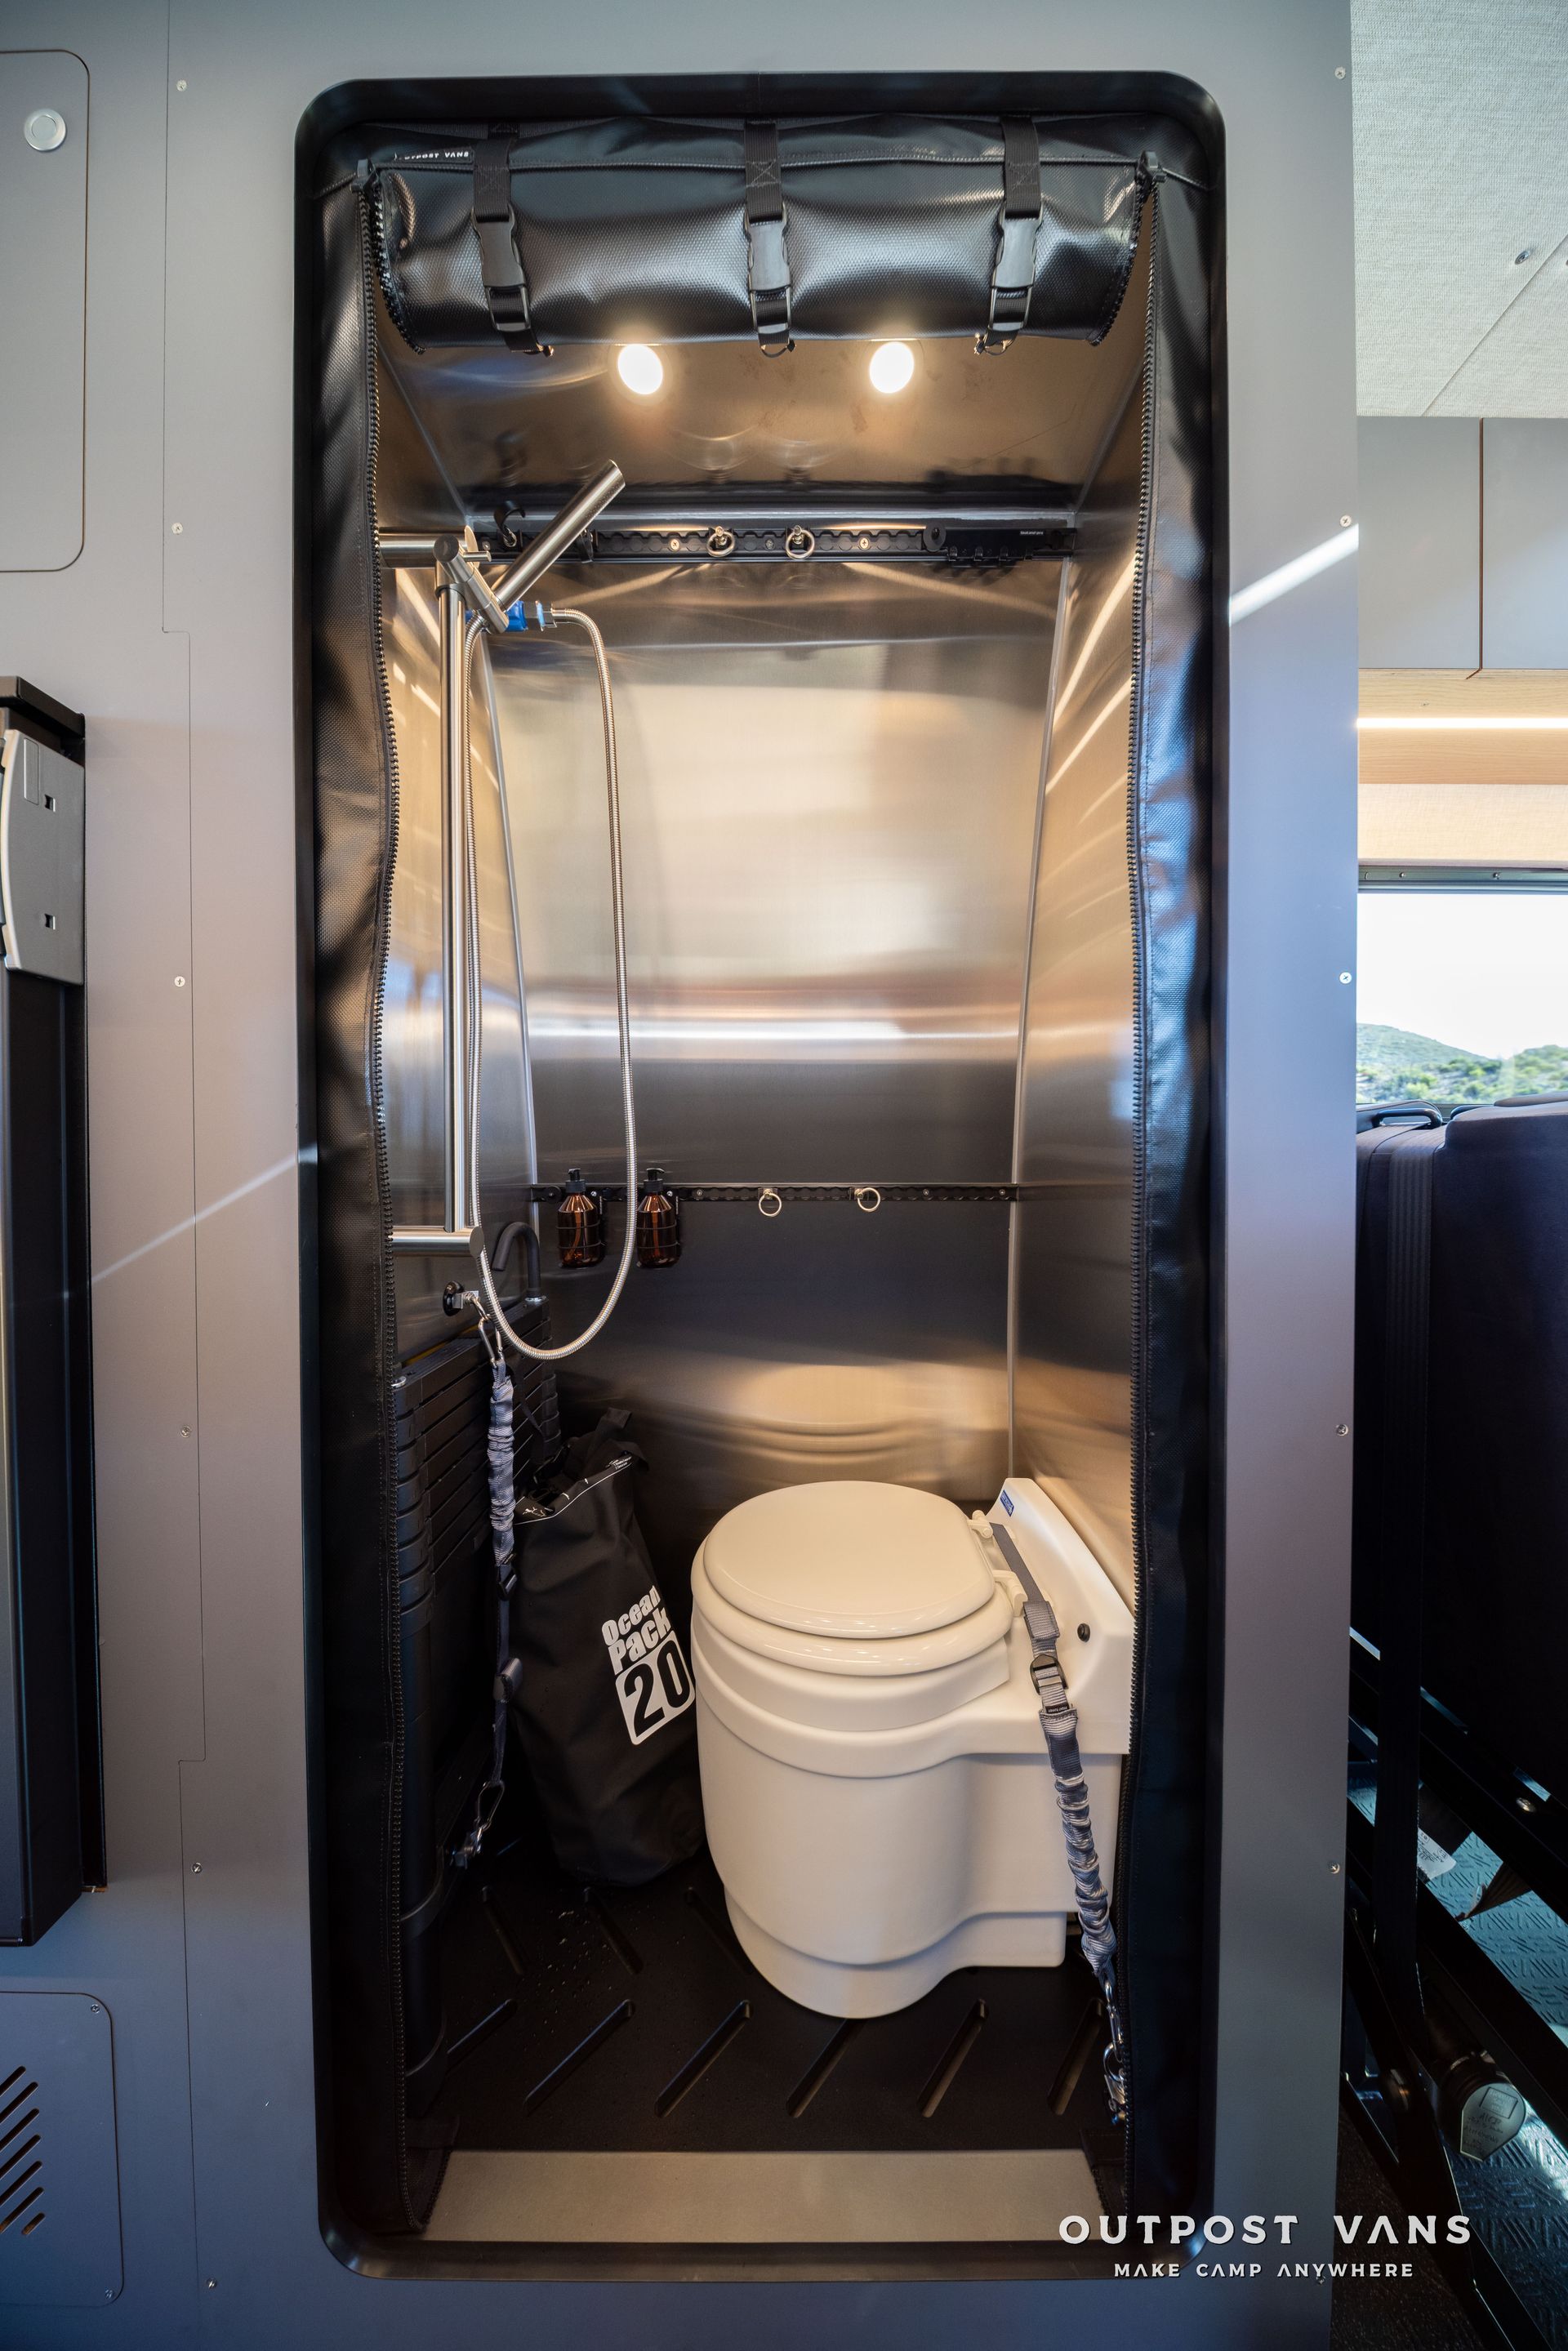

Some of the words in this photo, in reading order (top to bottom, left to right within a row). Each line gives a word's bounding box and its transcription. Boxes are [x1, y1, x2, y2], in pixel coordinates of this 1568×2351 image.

[444, 150, 469, 158] VANS
[601, 1585, 661, 1646] Ocean
[608, 1606, 671, 1676] Pack
[623, 1640, 691, 1738] 20
